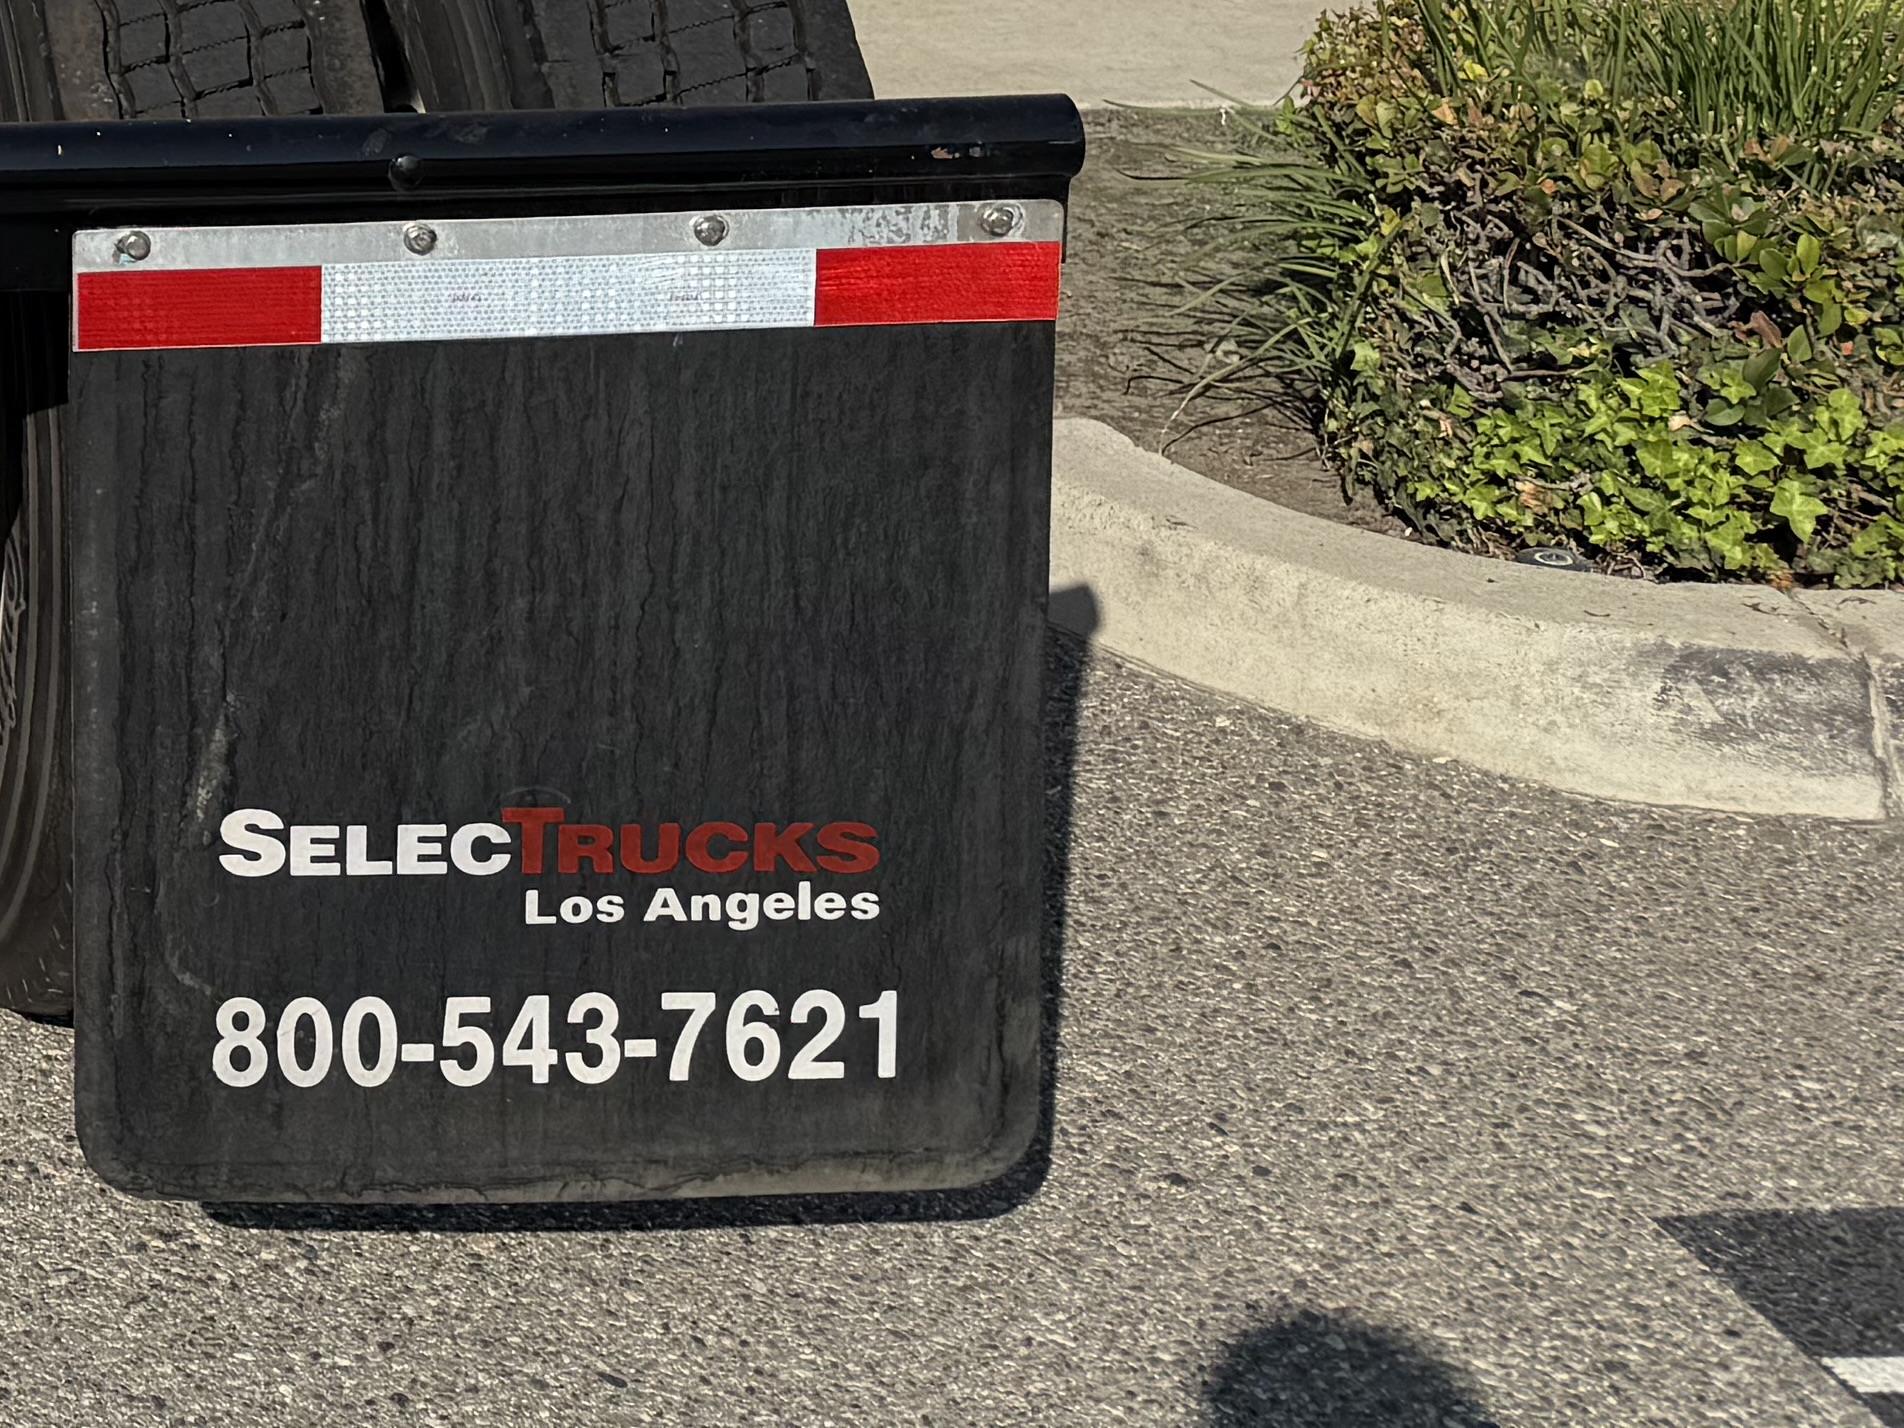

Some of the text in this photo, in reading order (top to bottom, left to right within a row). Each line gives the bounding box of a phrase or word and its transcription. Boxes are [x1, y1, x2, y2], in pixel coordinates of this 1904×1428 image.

[525, 880, 880, 931] Los Angeles
[212, 988, 898, 1088] 800-543-7621
